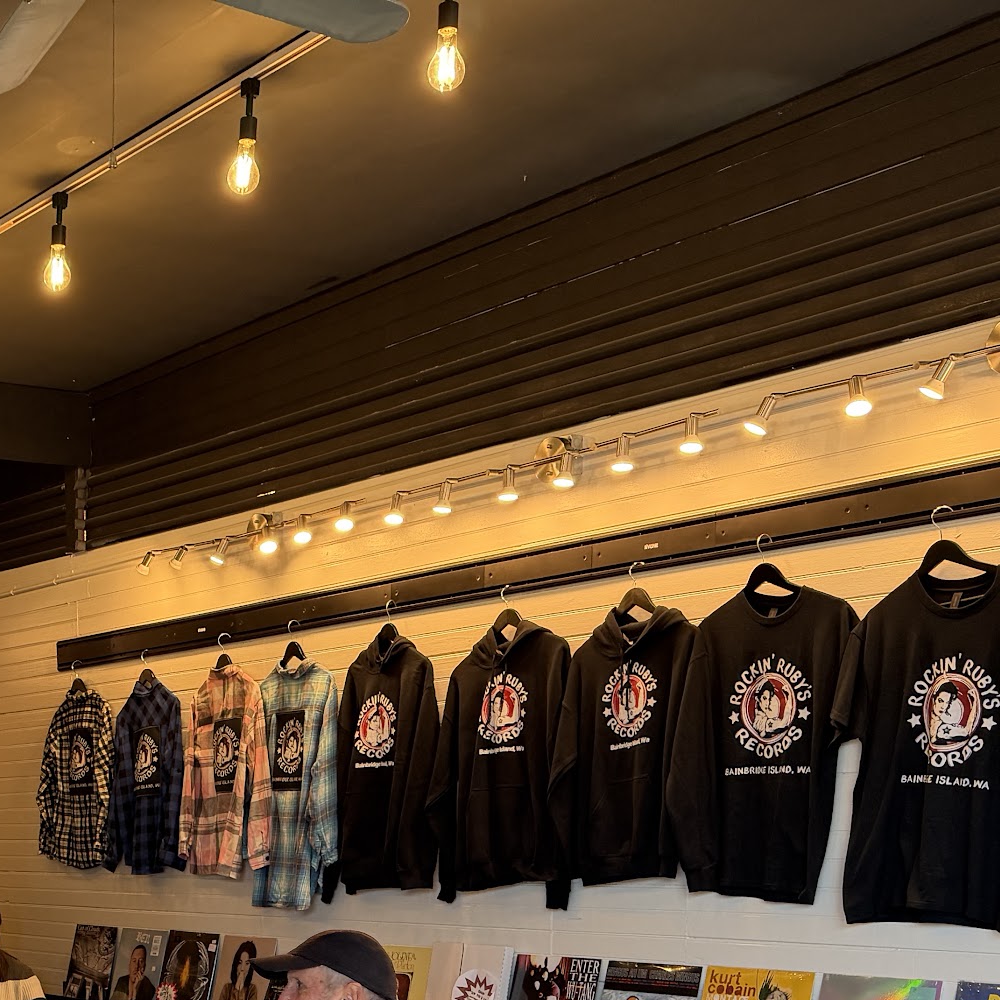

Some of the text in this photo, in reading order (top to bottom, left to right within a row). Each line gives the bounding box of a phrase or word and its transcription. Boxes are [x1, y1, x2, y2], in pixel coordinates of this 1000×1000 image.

[601, 659, 658, 703] ROCKN' RUBY'S
[729, 653, 813, 706] ROCKIN' RUBY'S
[907, 652, 962, 707] ROCKIN'
[734, 725, 803, 759] RECORDS
[914, 731, 985, 768] RORDS
[767, 765, 795, 775] ISLND,
[796, 765, 812, 774] WA
[972, 779, 990, 790] WA
[570, 959, 600, 974] ENTER
[569, 972, 599, 983] THE
[709, 969, 742, 985] kurt
[707, 983, 756, 997] cobain
